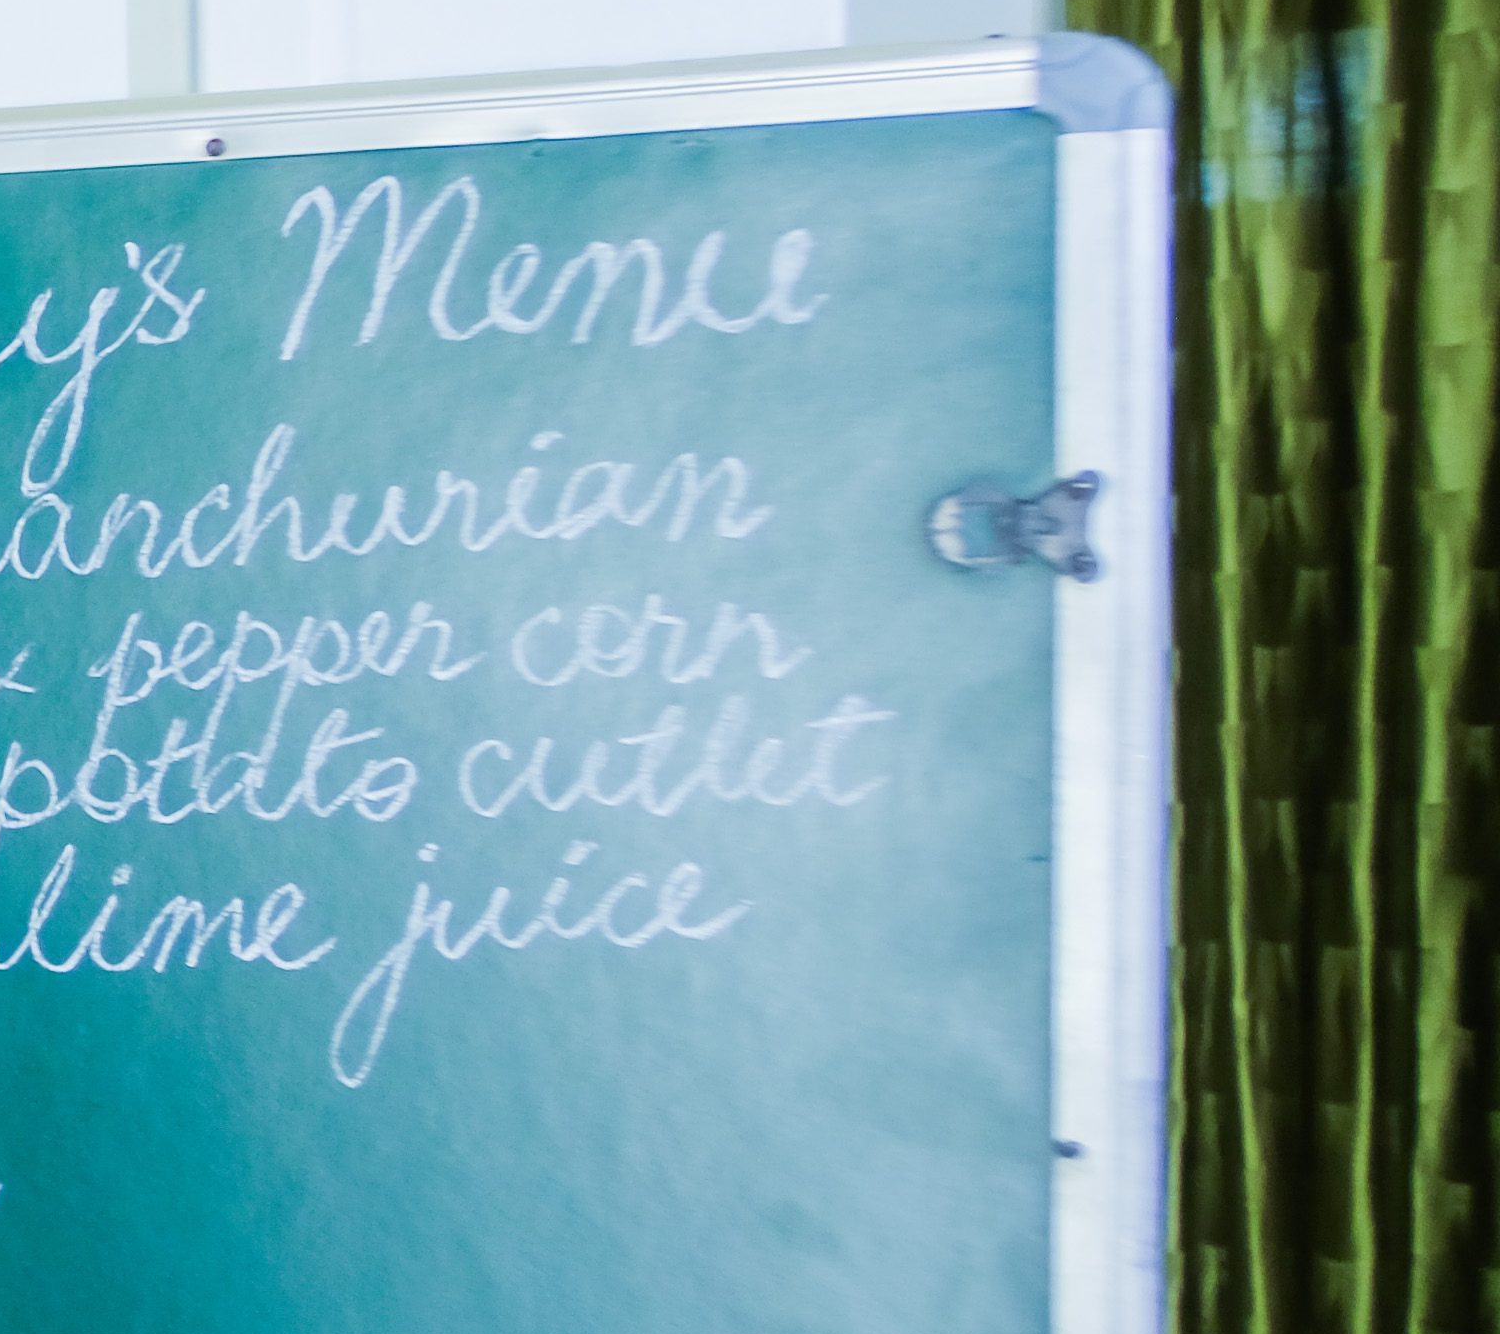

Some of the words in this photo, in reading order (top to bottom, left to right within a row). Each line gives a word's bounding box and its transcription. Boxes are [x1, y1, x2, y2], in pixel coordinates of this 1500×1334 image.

[280, 175, 824, 361] Menu
[87, 599, 490, 789] pepper
[510, 593, 818, 687] corn
[457, 693, 898, 819] cutlet
[330, 839, 758, 1089] juice
